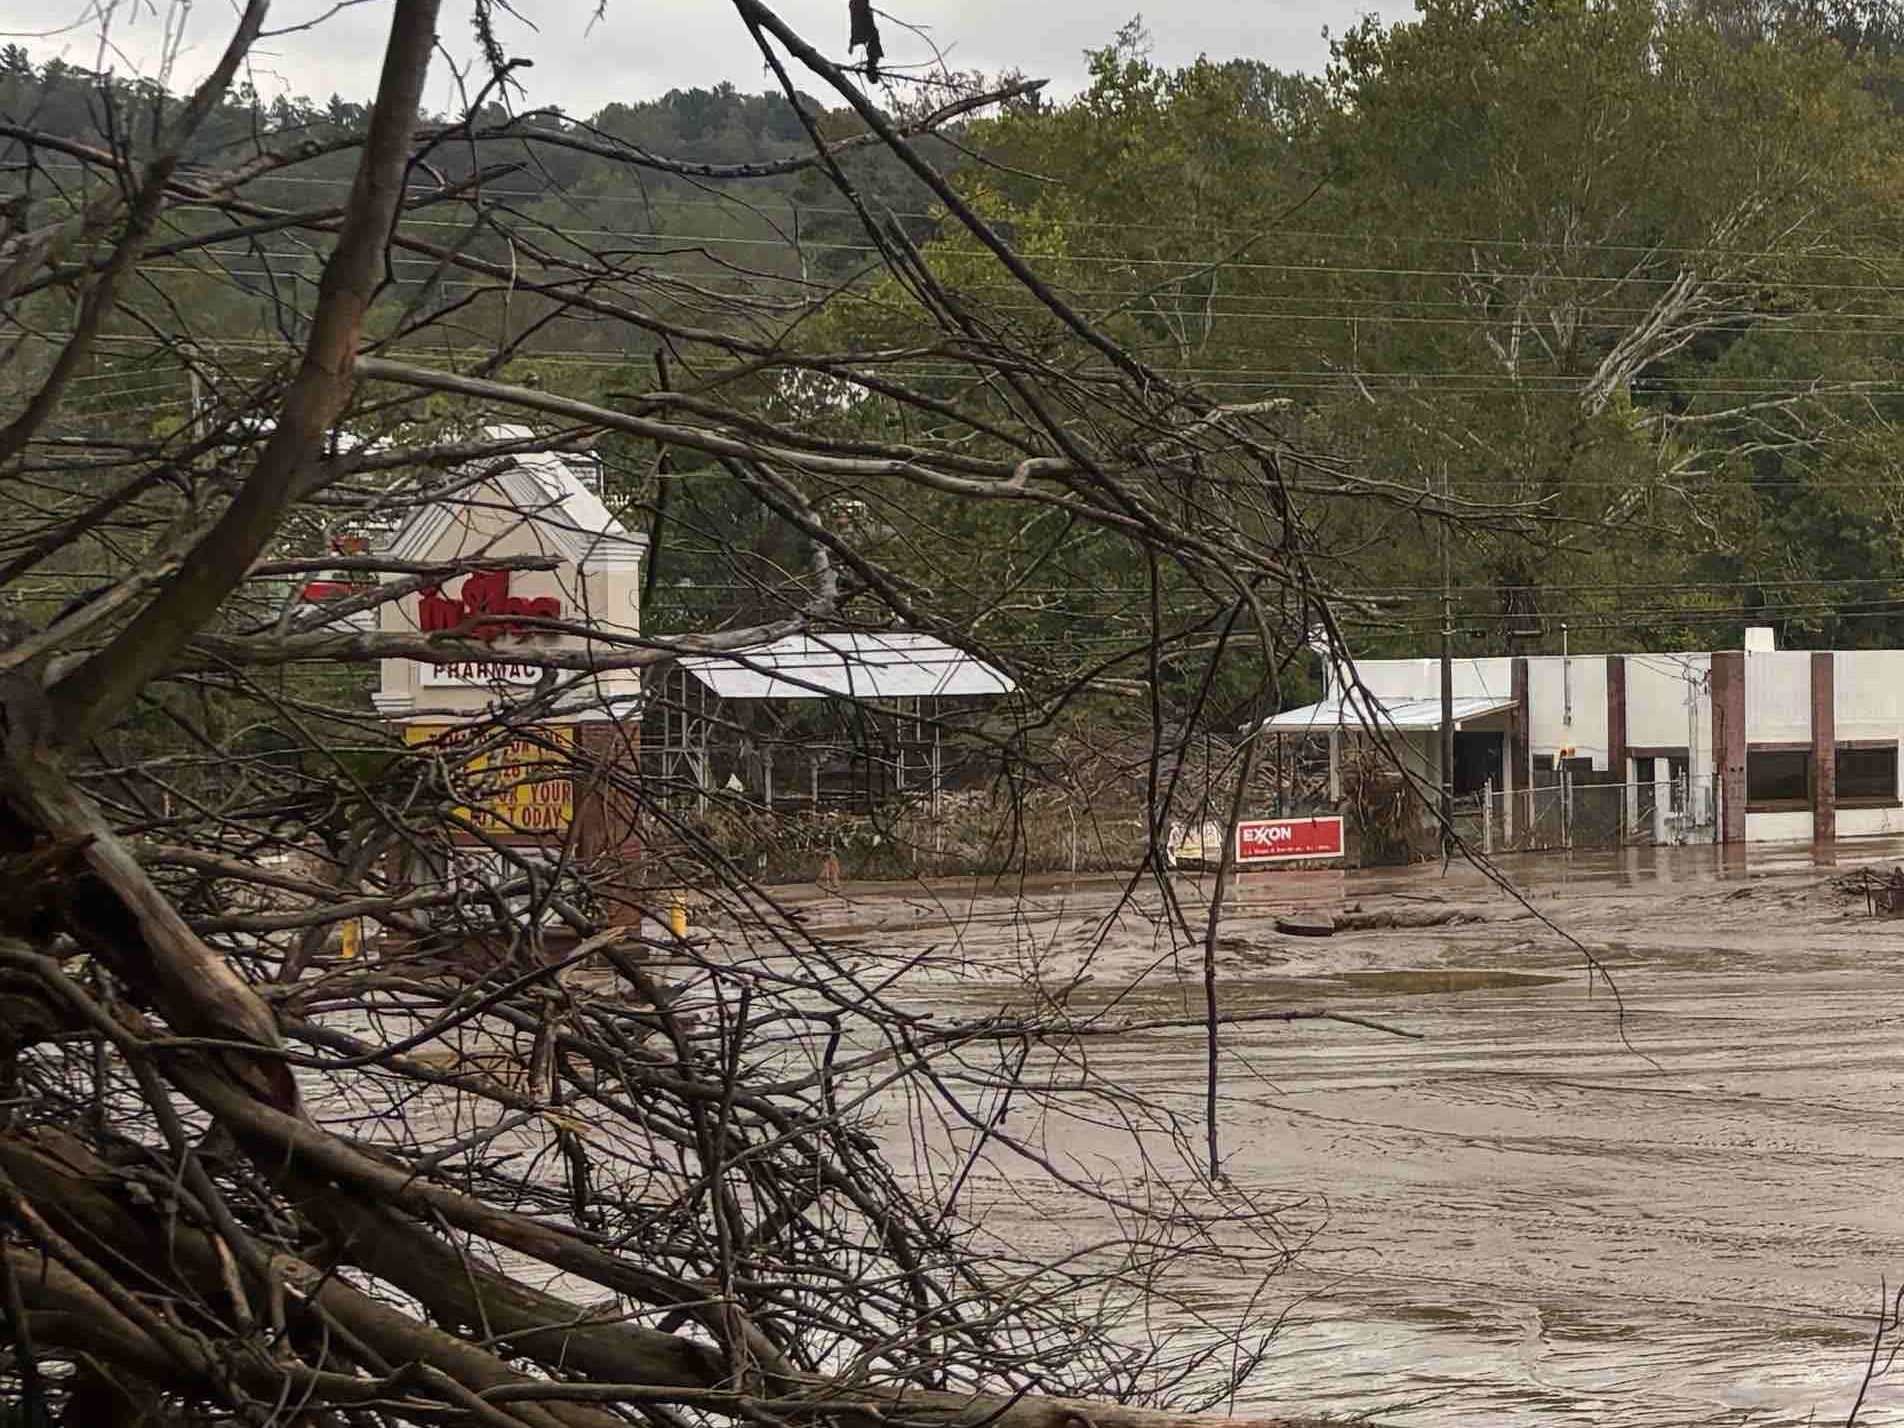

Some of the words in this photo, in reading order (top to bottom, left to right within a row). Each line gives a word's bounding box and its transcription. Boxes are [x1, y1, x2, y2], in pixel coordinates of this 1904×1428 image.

[433, 660, 540, 679] PHARMAC
[531, 779, 572, 804] YOUR
[1242, 826, 1292, 846] EXXON
